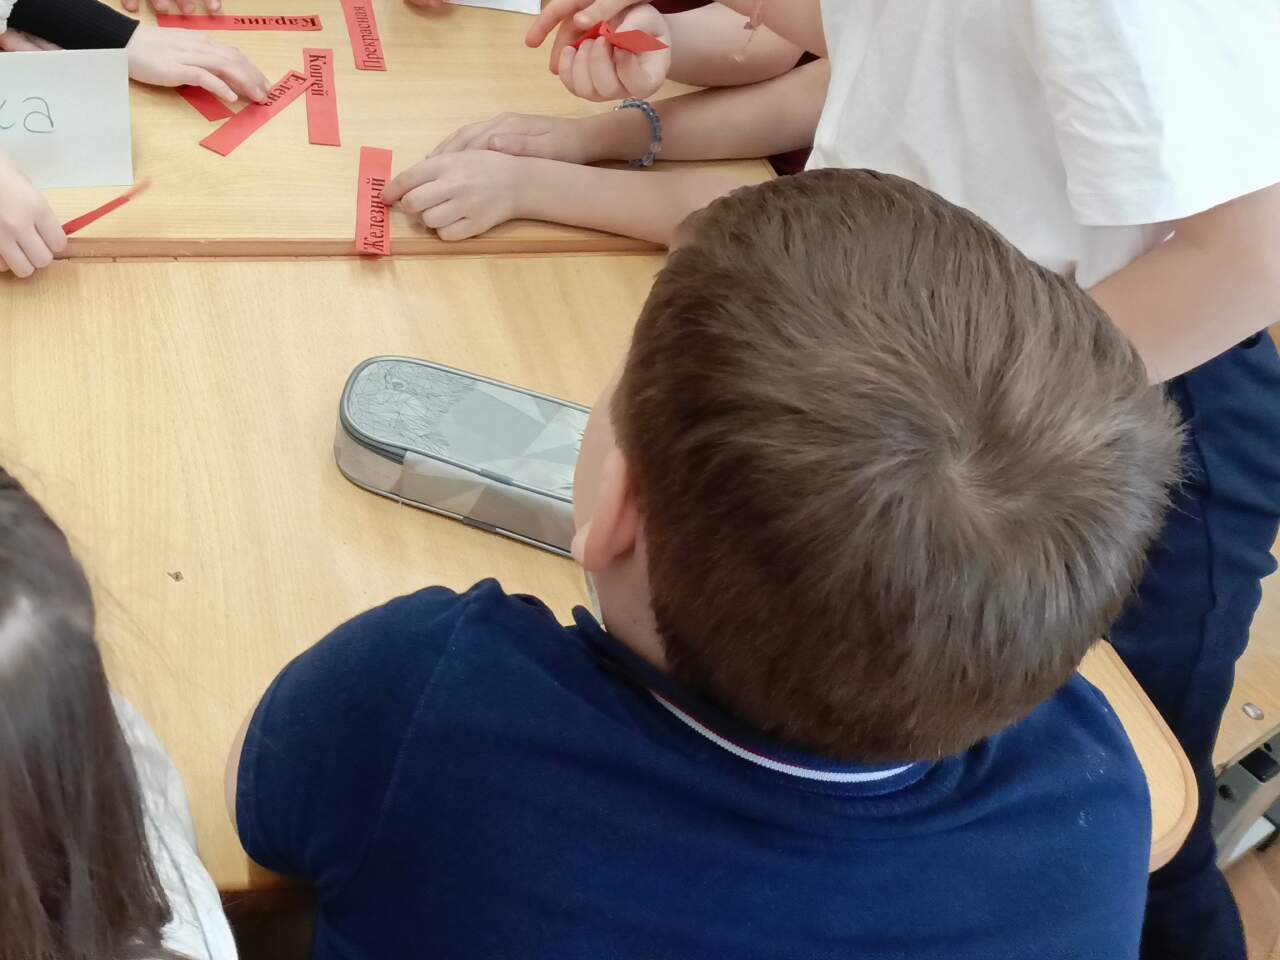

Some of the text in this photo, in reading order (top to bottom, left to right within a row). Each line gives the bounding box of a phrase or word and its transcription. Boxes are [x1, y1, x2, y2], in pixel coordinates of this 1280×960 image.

[233, 15, 320, 29] Карлик
[354, 6, 384, 70] Прекрасная
[362, 177, 387, 253] Железный
